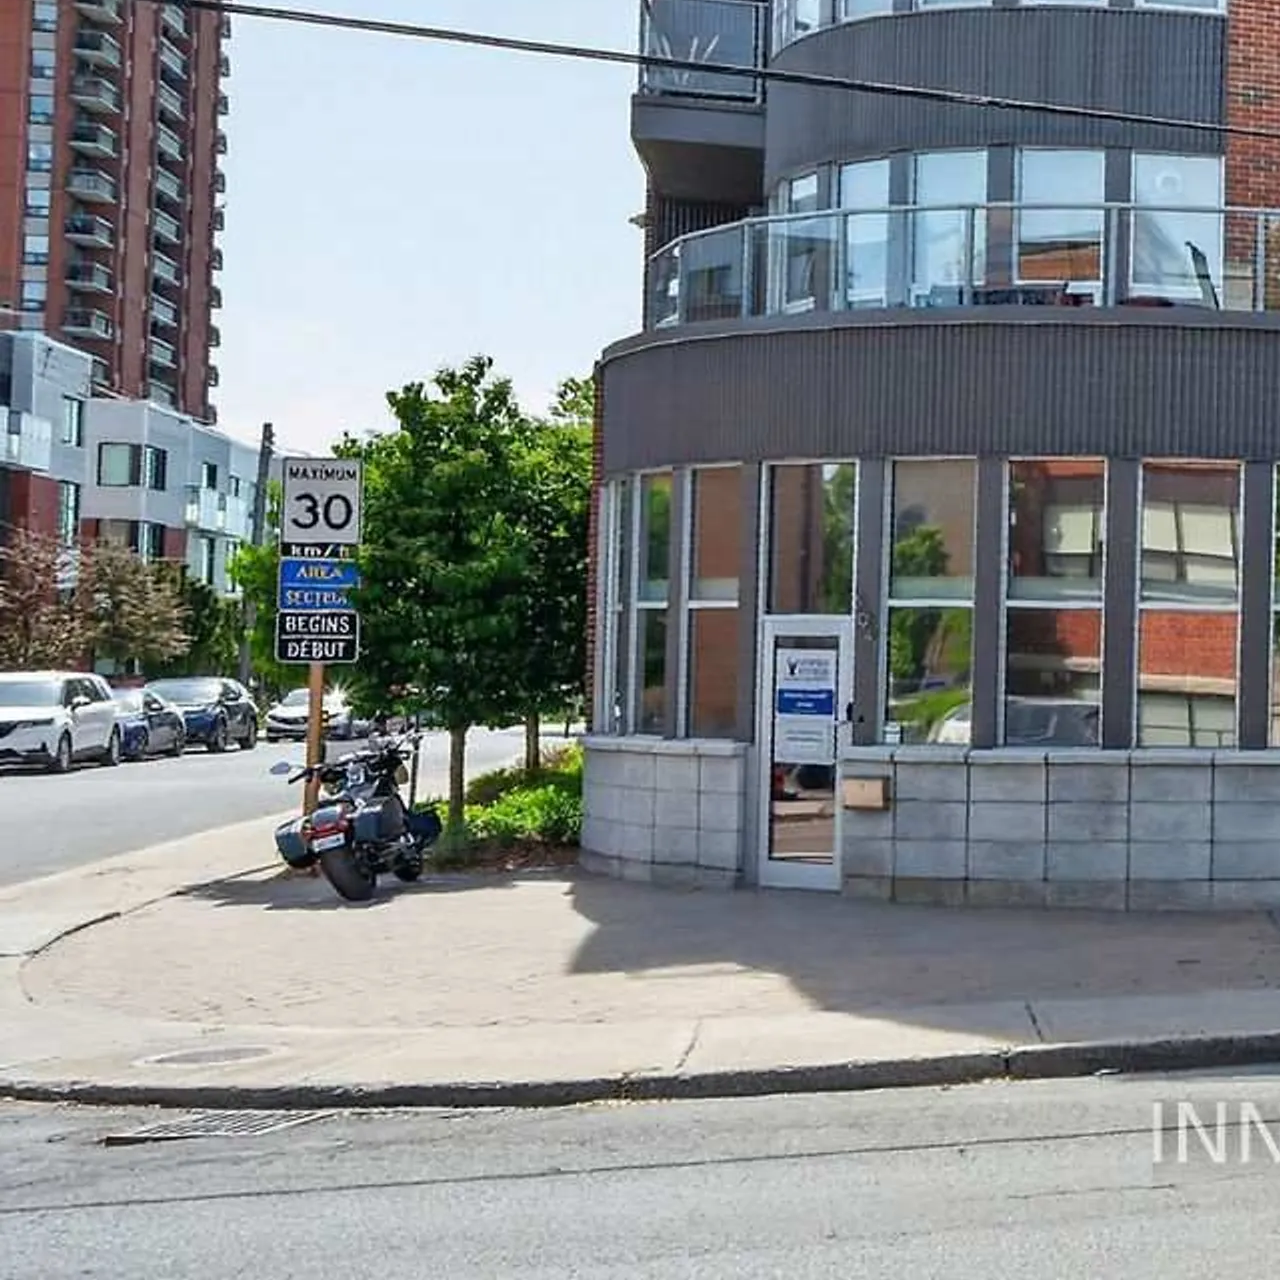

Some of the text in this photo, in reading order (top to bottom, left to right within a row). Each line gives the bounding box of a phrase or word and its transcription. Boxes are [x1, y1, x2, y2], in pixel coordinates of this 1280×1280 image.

[288, 466, 357, 481] MAXIMUM
[291, 493, 353, 530] 30
[291, 543, 350, 558] km/h
[285, 616, 350, 633] BEGINS
[287, 639, 346, 658] DÉBUT
